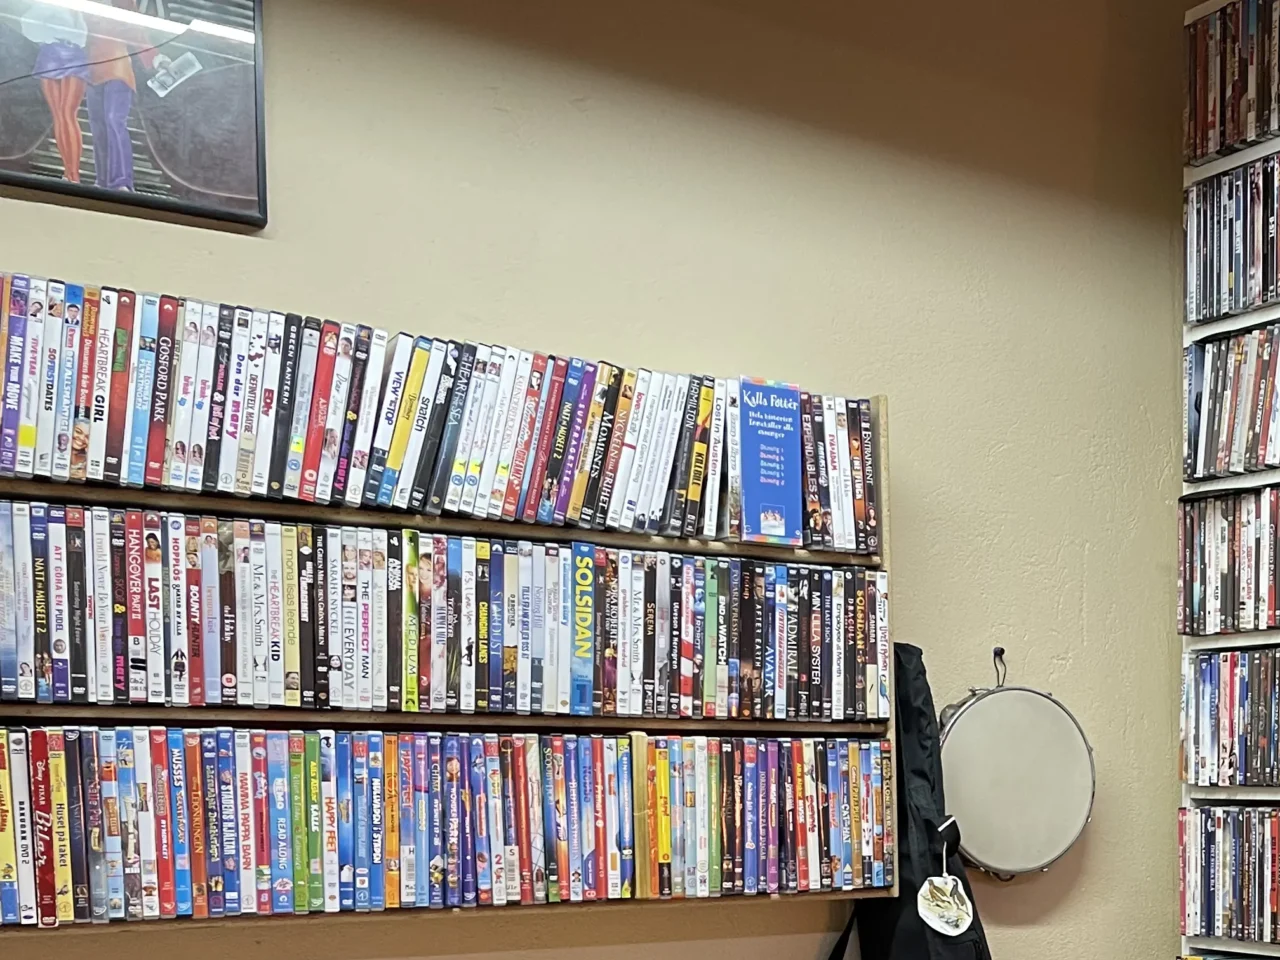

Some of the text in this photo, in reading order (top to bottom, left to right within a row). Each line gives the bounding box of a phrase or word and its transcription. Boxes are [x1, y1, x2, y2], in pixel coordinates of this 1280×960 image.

[9, 336, 23, 363] MAKE
[93, 328, 109, 423] HEARTBREAK GIRL
[235, 354, 246, 374] Den
[283, 326, 297, 404] GREEN LANTERN
[6, 382, 20, 410] MOVE
[153, 337, 171, 422] GOSFORD PARK
[385, 371, 404, 425] VIEW TOP
[448, 361, 471, 424] HEART SEA
[686, 381, 700, 428] HAMILTON
[225, 400, 241, 439] mary
[415, 397, 431, 432] snatch
[611, 409, 628, 458] NYCKELN
[564, 403, 585, 482] SUFFRAGETTE
[591, 411, 614, 478] MOMENTS
[802, 415, 818, 501] EXPENDABLES 2
[863, 431, 874, 485] ENTRAPMENT
[599, 471, 615, 509] FRIHET
[129, 529, 142, 592] HANGOVER
[56, 608, 64, 632] PUDEL
[131, 594, 142, 612] PART
[148, 577, 161, 655] LAST HOLIDAY
[286, 549, 297, 645] mona lisas leende
[330, 559, 339, 635] SARAHS NYCKEL
[575, 556, 592, 657] SOLSIDAN
[646, 603, 655, 635] SERENA
[361, 603, 370, 653] PERFECT
[408, 615, 417, 675] MEDIUM
[491, 592, 503, 657] STARDUST
[812, 592, 821, 684] MIN LILLA SYSTER
[115, 655, 126, 689] mary
[361, 655, 369, 678] MAN
[765, 646, 774, 697] AVATAR
[172, 748, 182, 786] MUSSES
[36, 810, 52, 866] Bilar
[56, 803, 65, 828] Huset
[221, 785, 235, 854] STADENS HJÄLTAR
[240, 773, 252, 870] MAMMA PAPPA BARN
[278, 818, 286, 840] READ
[326, 797, 336, 853] HAPPY FEET
[59, 844, 68, 867] taket
[278, 841, 287, 869] ALONG
